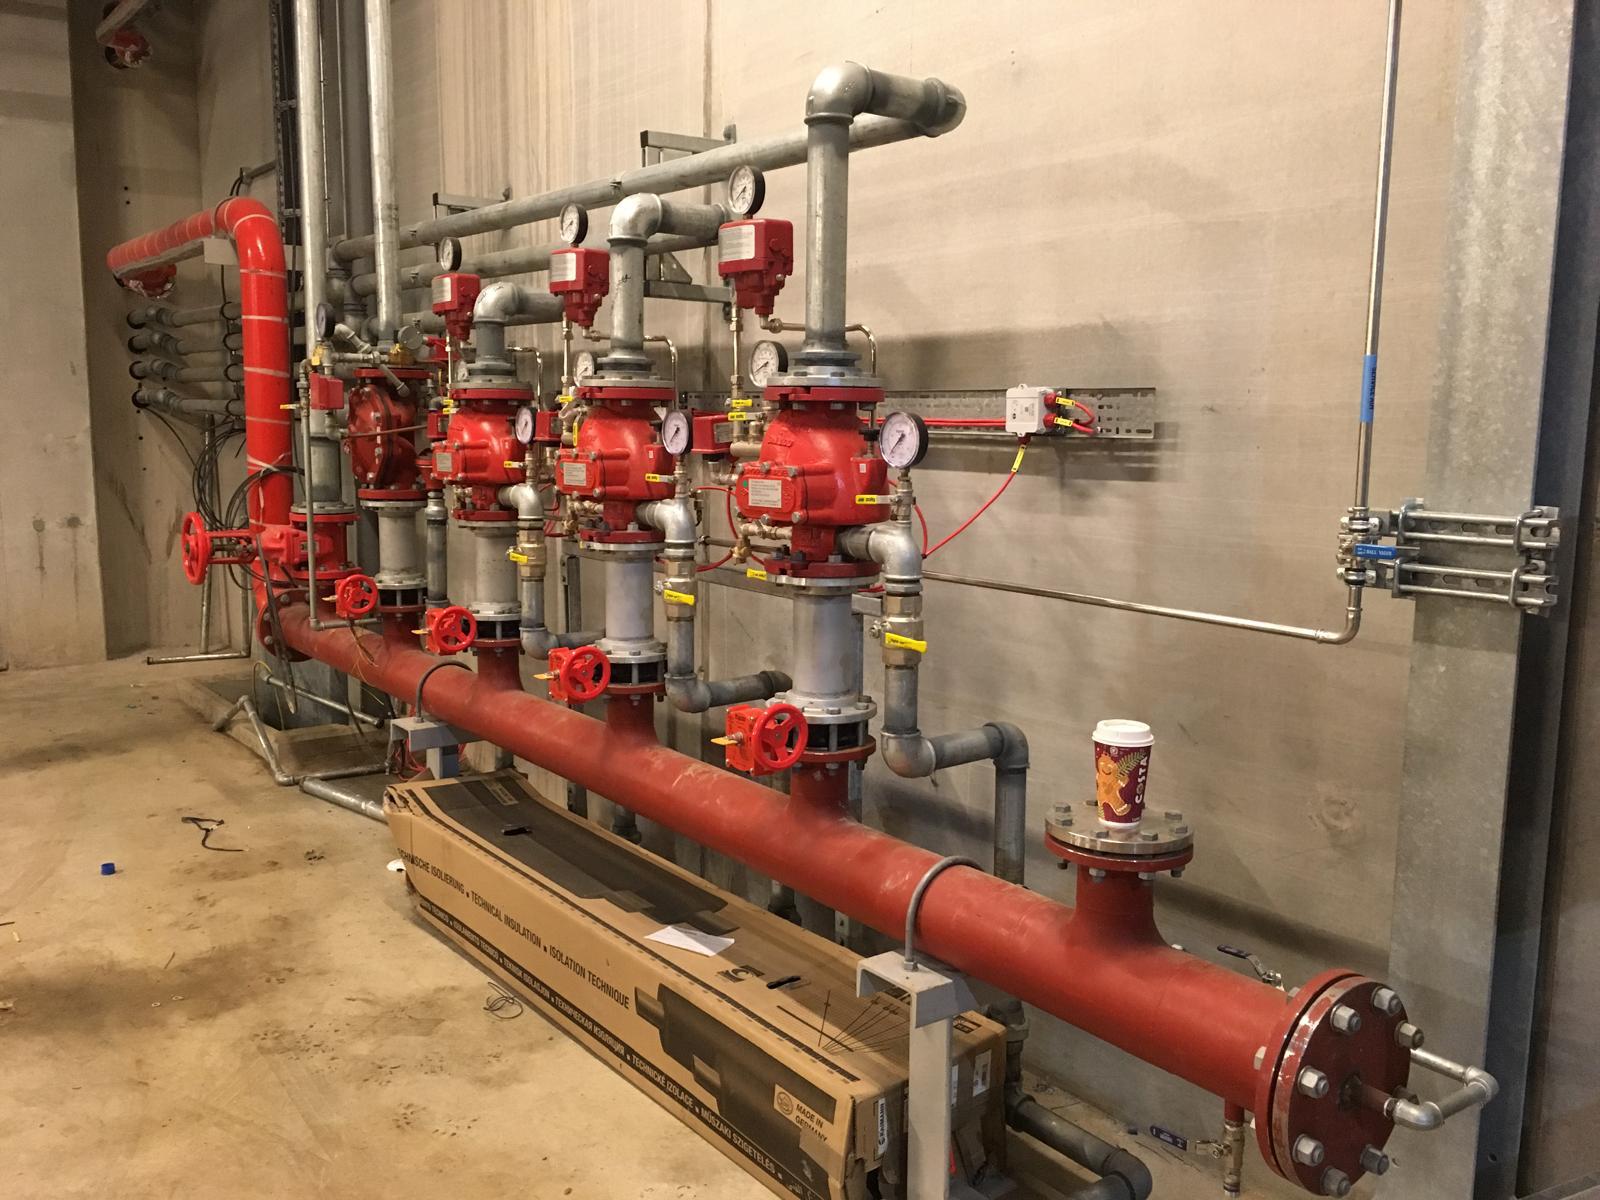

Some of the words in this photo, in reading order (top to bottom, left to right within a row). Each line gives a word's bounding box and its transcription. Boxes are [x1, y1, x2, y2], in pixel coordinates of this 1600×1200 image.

[1135, 756, 1147, 803] COSTA
[431, 865, 465, 897] ISOLIERUNG
[471, 890, 503, 922] TECHNICAL
[504, 913, 542, 949] INSULATION
[549, 944, 586, 980] ISOLATION
[587, 970, 630, 1010] TECHNIQUE
[667, 1081, 694, 1110] IZOLACE
[796, 1103, 815, 1123] MADE
[816, 1117, 824, 1128] IN
[732, 1134, 776, 1175] SZIGETELÉS
